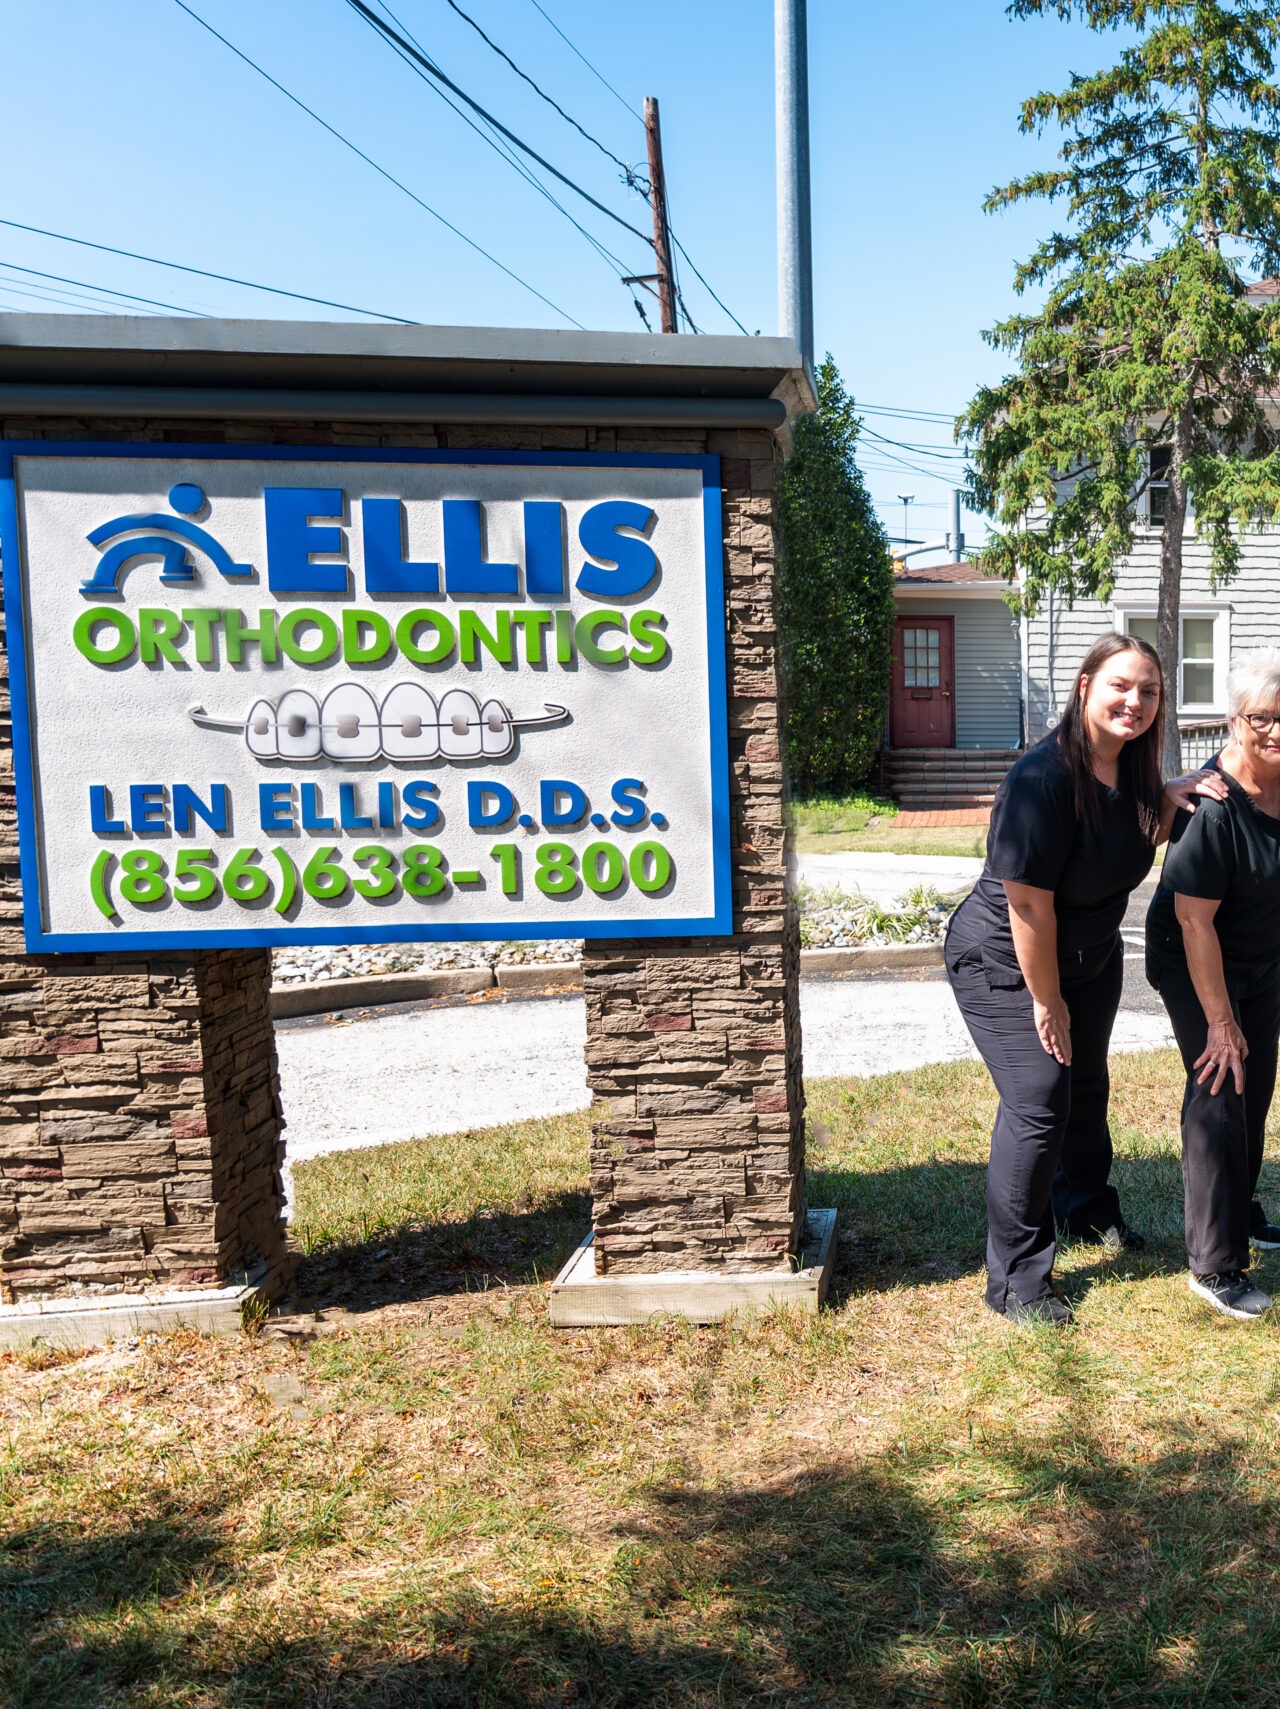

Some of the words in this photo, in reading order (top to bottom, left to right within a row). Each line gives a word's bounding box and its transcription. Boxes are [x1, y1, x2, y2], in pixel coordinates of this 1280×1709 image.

[263, 486, 658, 597] ELLIS
[72, 606, 669, 665] ORTHODONTICS
[89, 783, 229, 833] LEN
[259, 780, 440, 831] ELLIS
[467, 778, 667, 828] D.D.S.
[89, 840, 673, 919] (856)638-1800
